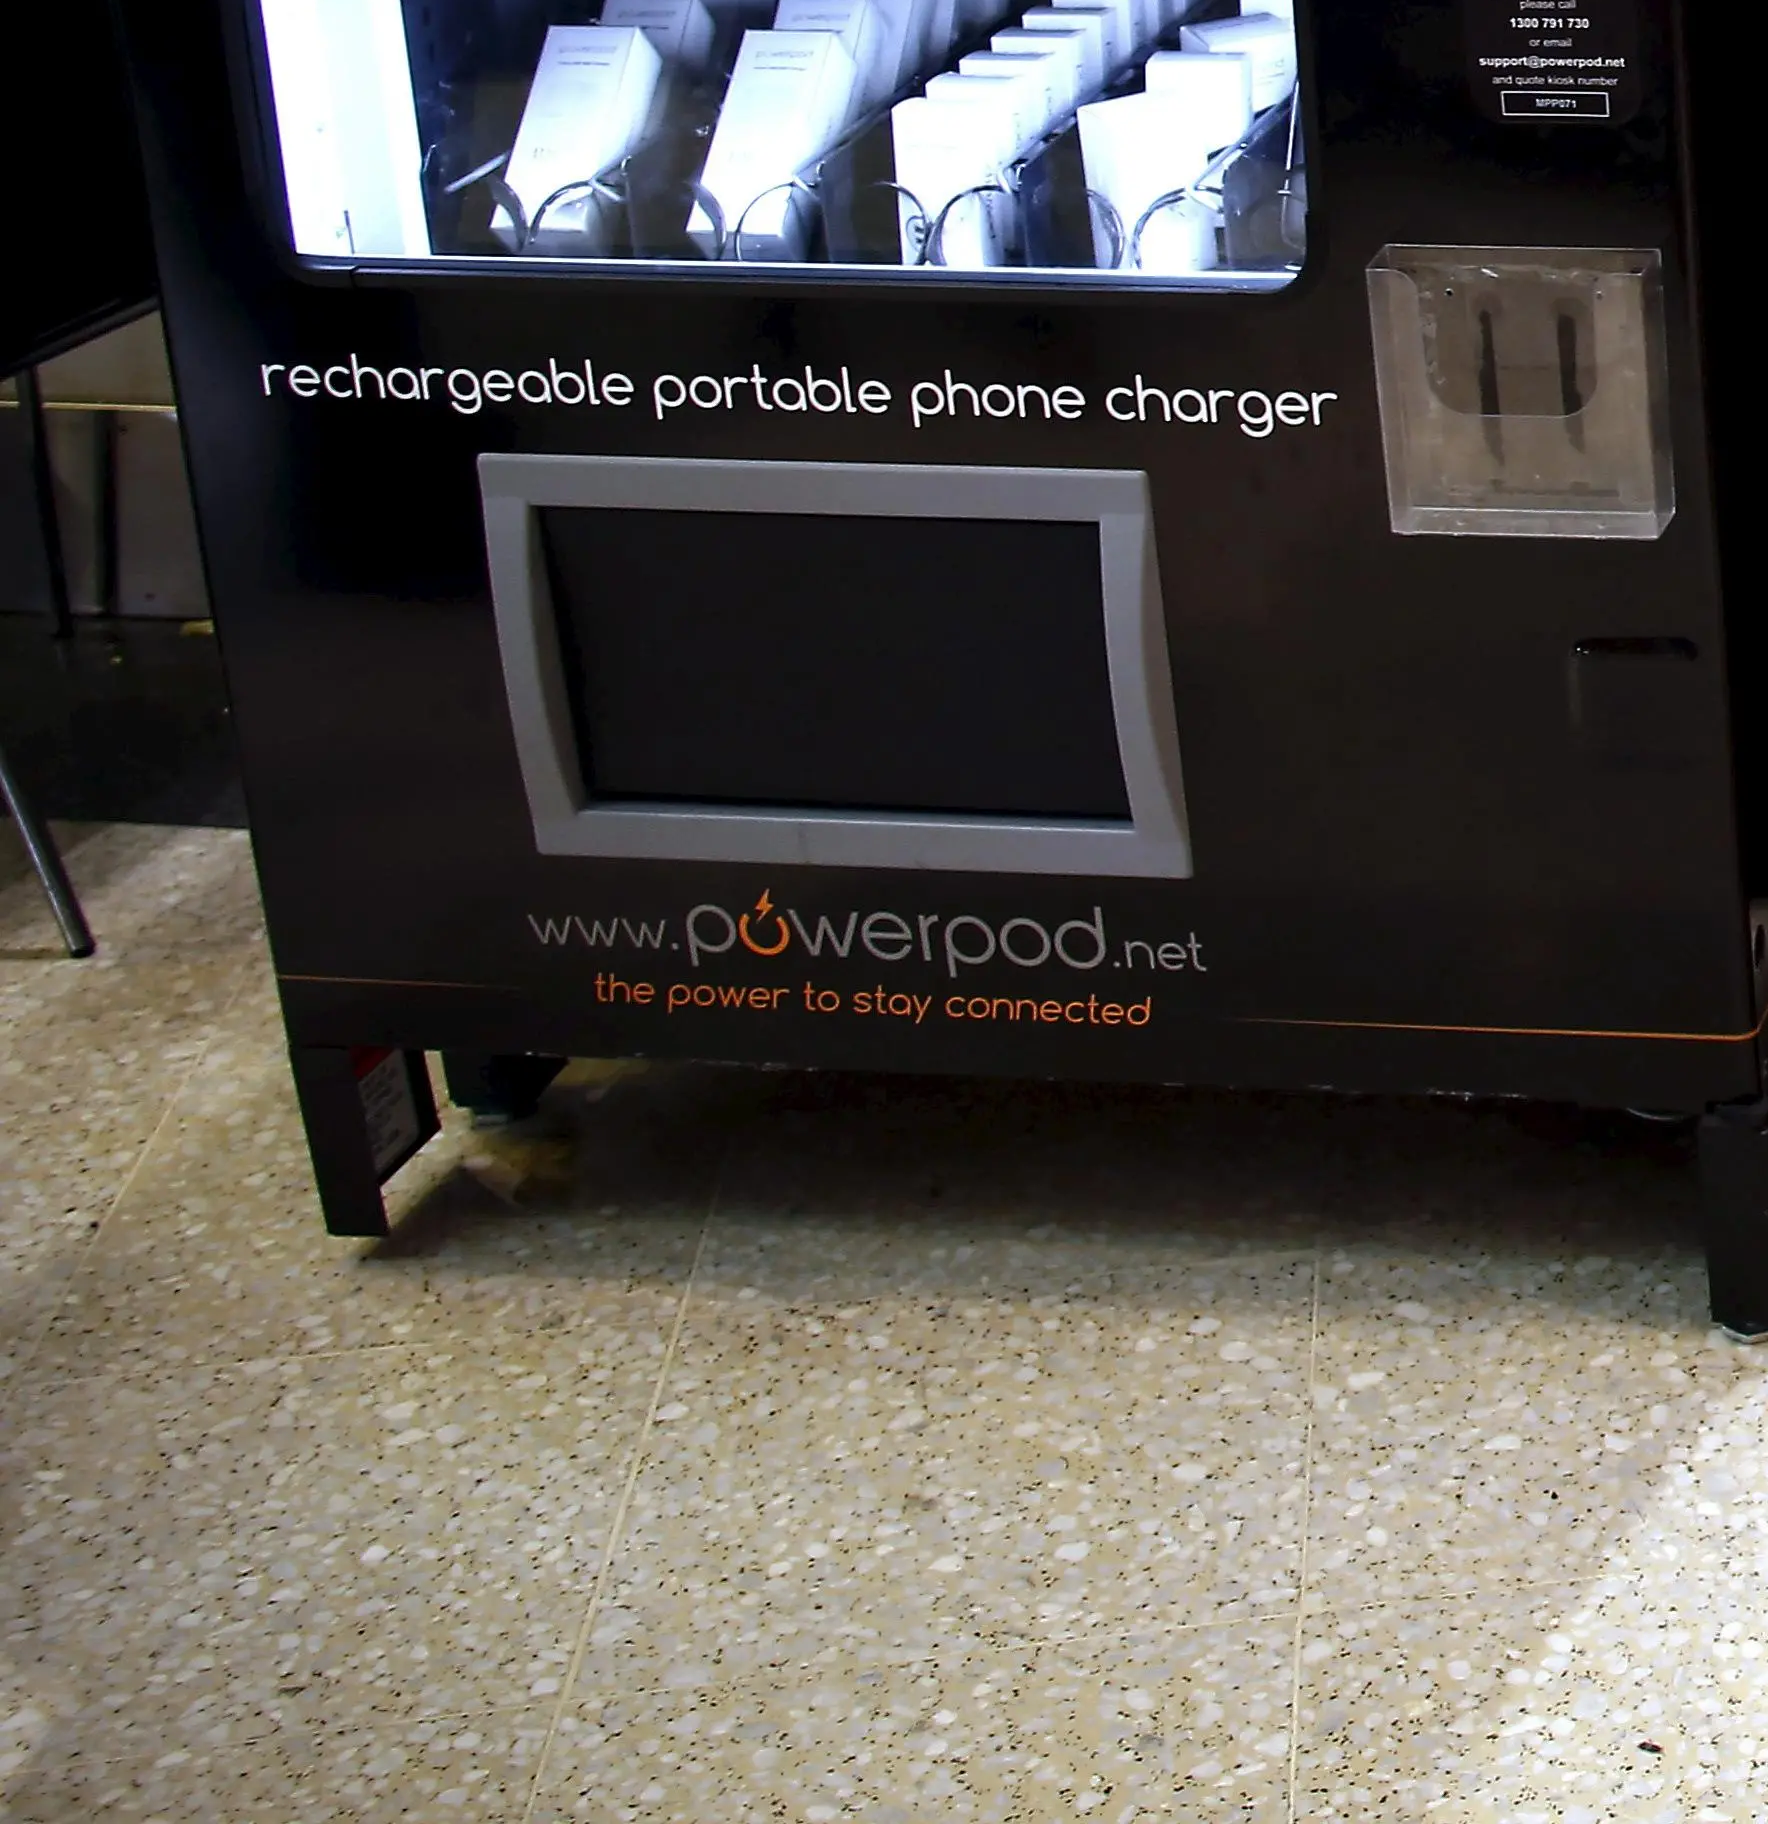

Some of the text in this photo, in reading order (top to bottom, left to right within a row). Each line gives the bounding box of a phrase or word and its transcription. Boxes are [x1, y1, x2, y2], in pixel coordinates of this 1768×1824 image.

[1519, 0, 1576, 10] please call
[1542, 18, 1563, 28] 791
[1529, 37, 1572, 47] or email
[1479, 55, 1625, 69] support@powerpod.net
[1492, 75, 1618, 86] and quote kiosk number
[261, 353, 1338, 438] rechargeable portable phone charger
[528, 889, 1207, 978] www.powerpod.net
[594, 973, 1152, 1027] the power to stay connected
